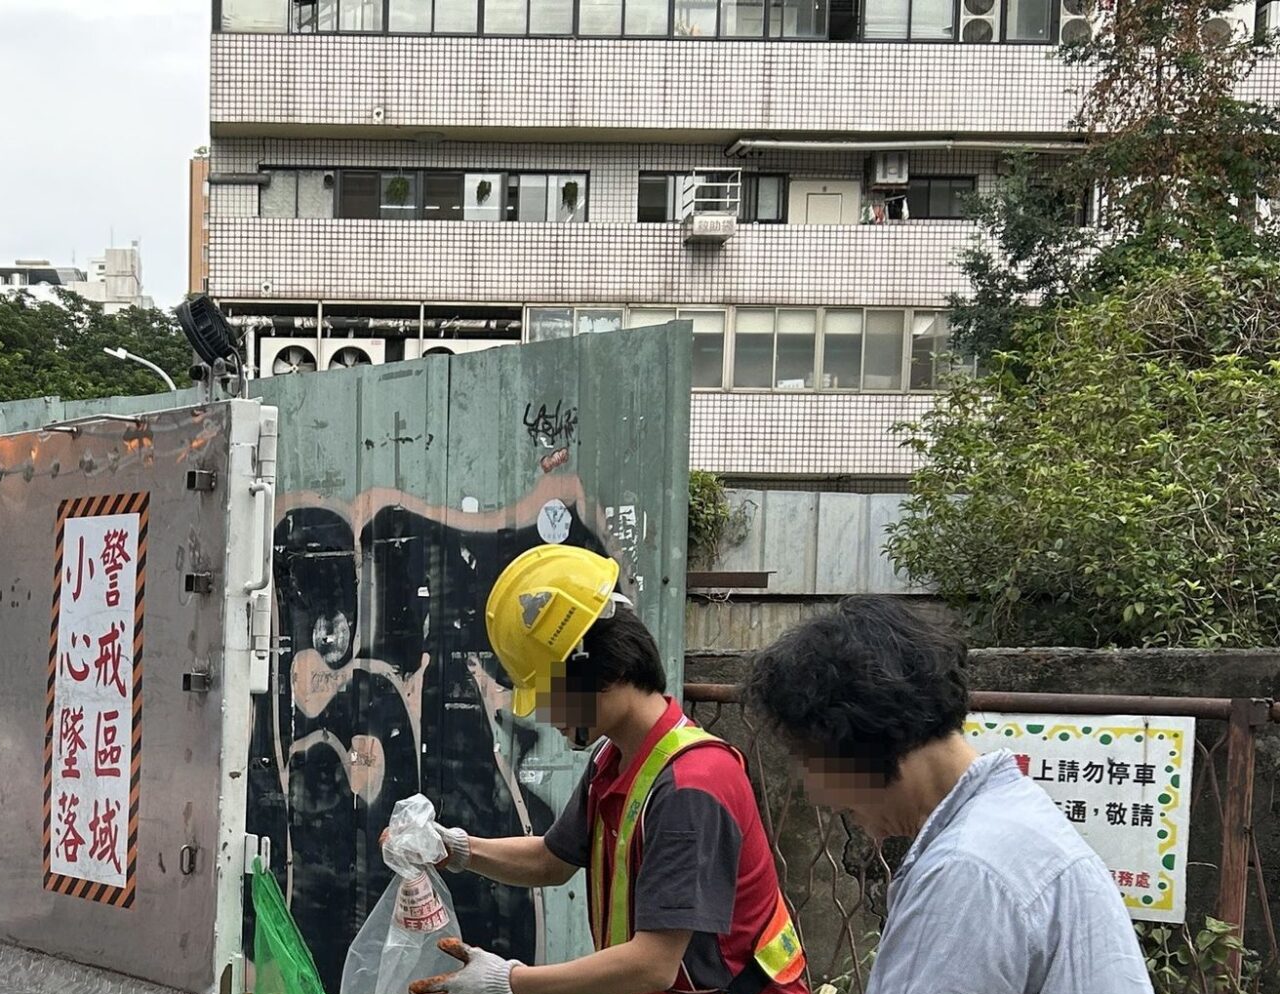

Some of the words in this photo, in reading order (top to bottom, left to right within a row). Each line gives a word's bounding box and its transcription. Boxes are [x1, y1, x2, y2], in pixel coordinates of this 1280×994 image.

[55, 535, 94, 864] 小心墜落
[88, 528, 131, 874] 警戒區域
[1055, 799, 1154, 827] 通，敬請
